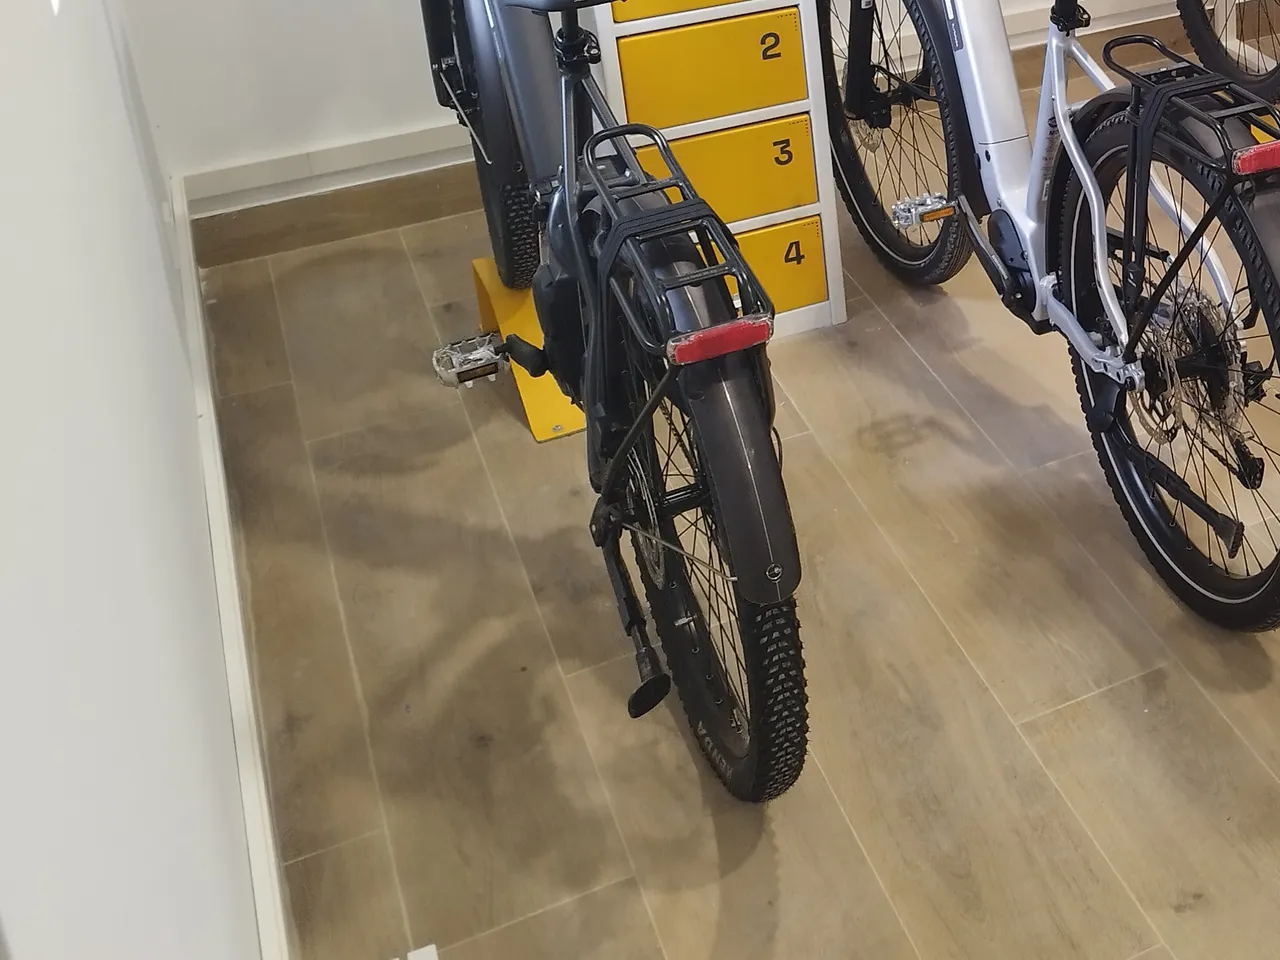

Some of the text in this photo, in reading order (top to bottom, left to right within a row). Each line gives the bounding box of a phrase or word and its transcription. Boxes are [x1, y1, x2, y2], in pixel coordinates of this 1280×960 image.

[760, 32, 782, 61] 2
[772, 139, 793, 166] 3
[783, 240, 805, 266] 4
